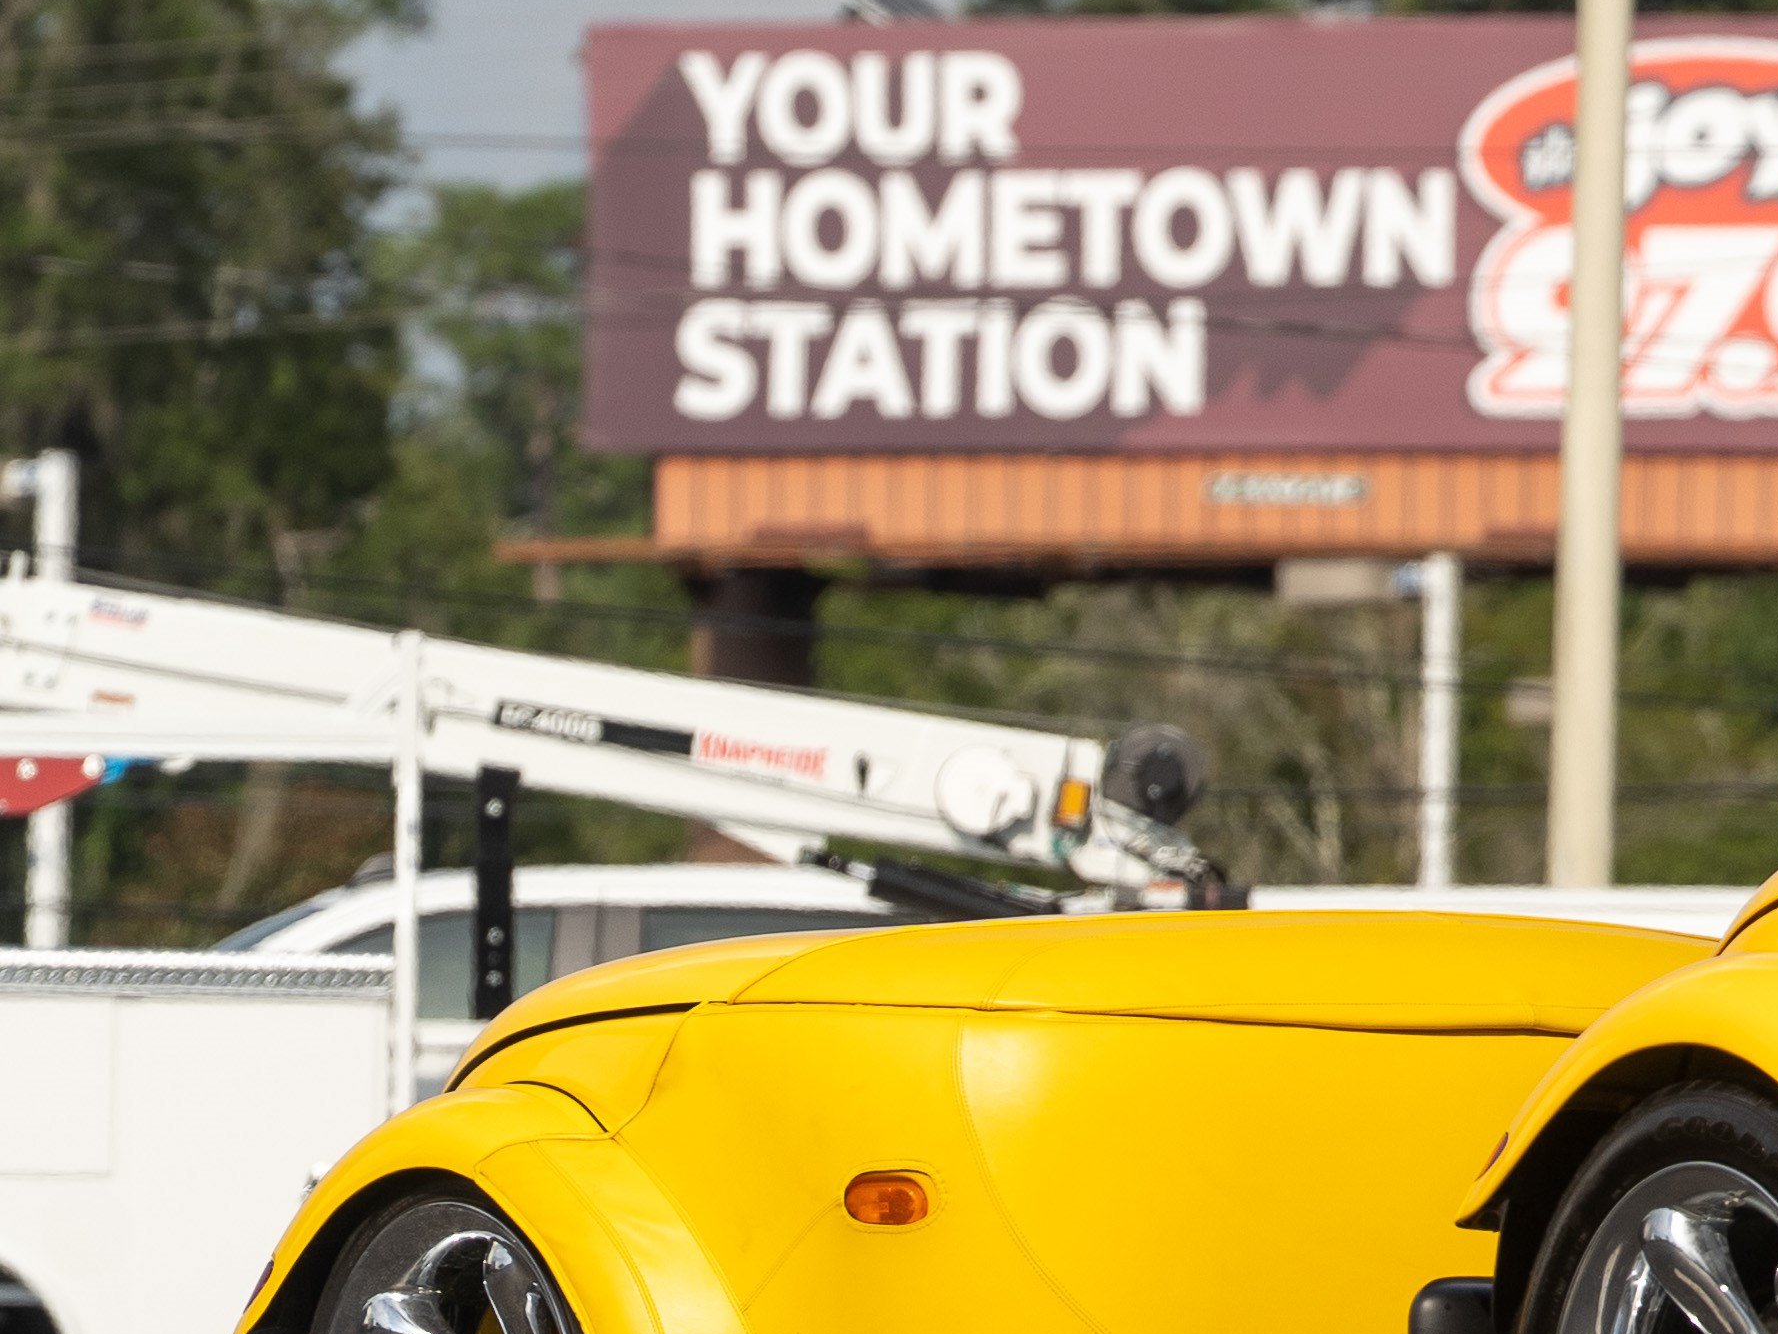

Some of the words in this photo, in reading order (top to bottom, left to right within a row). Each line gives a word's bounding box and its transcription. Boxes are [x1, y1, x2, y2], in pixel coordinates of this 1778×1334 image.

[681, 51, 1023, 167] YOUR
[689, 167, 1456, 289] HOMETOWN
[674, 298, 1206, 419] STATION
